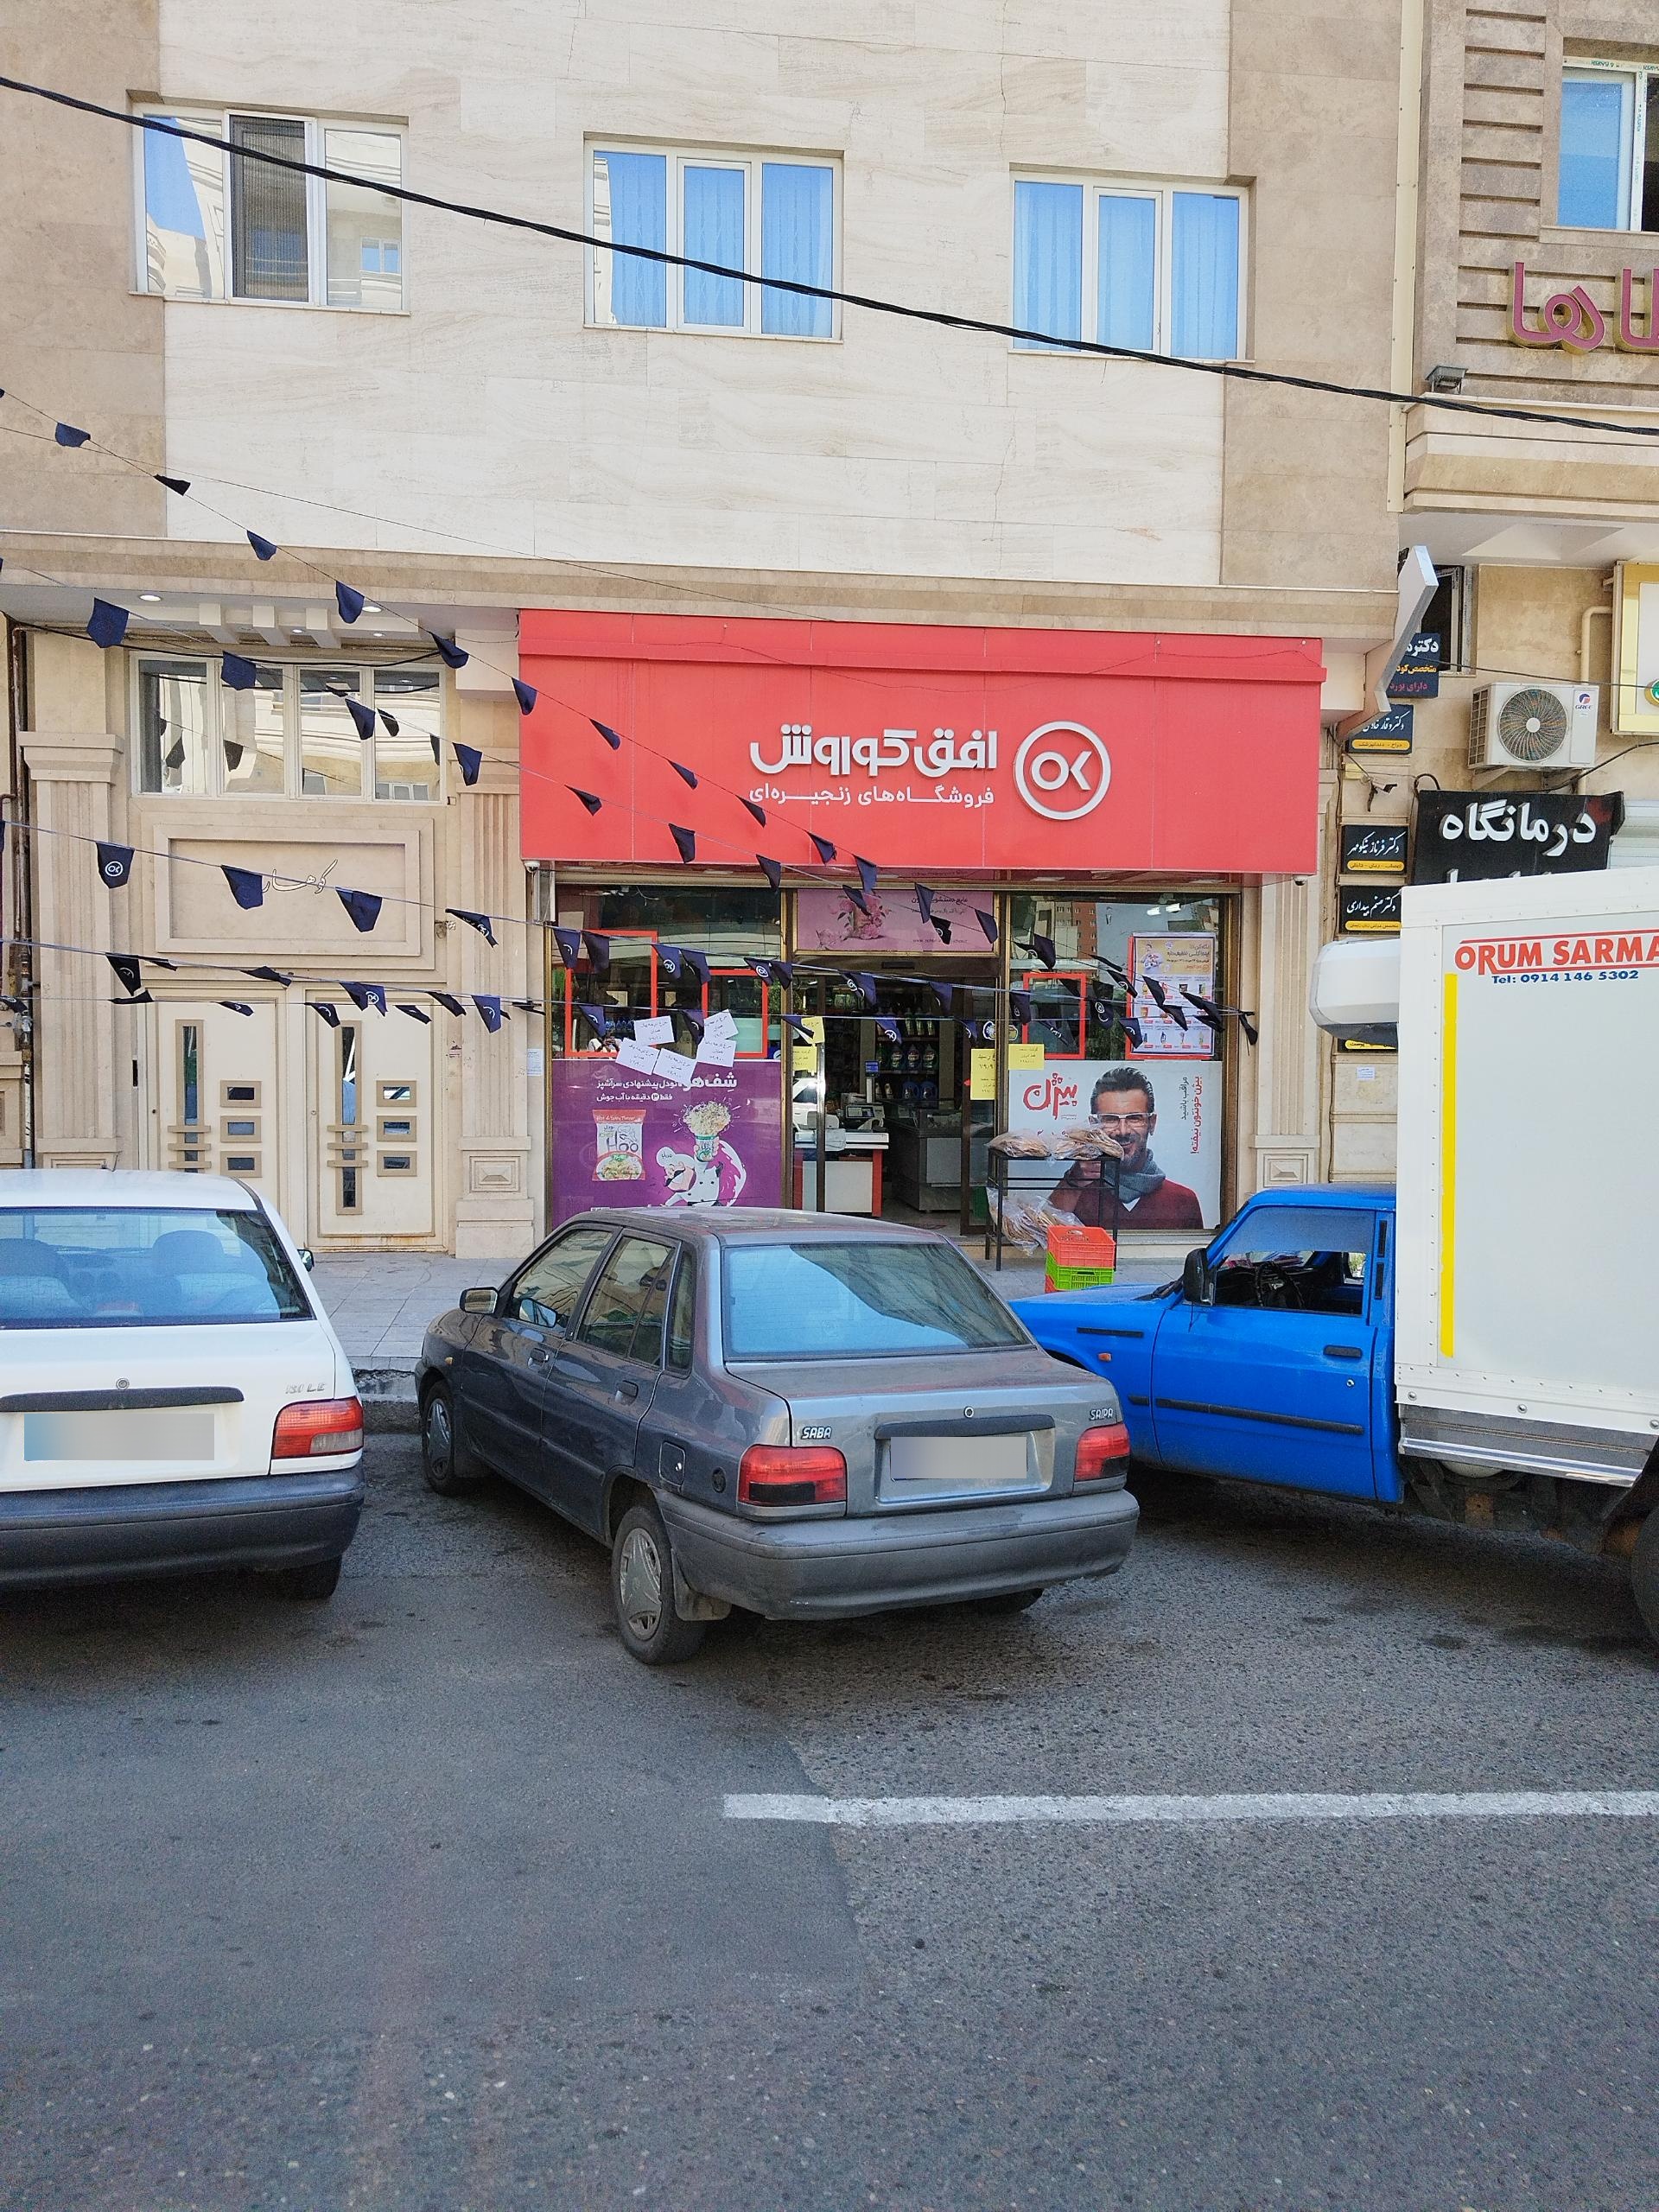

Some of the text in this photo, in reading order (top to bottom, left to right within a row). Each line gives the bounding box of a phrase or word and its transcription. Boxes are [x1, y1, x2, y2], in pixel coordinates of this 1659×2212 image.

[1390, 710, 1411, 733] دکتر
[749, 723, 998, 778] افق کوروش
[1031, 750, 1092, 791] OK
[1440, 798, 1597, 857] درمانگاه
[1383, 831, 1406, 855] دکتر
[1380, 889, 1402, 914] دکتر
[1454, 936, 1659, 976] ORUM SARMA
[1491, 969, 1640, 984] Tel: 0914 146 5302
[596, 1077, 622, 1090] سرآشپز
[622, 1079, 659, 1090] پیشنهادی
[1192, 1076, 1203, 1096] بیژن
[596, 1093, 615, 1102] جوش
[615, 1092, 625, 1102] آب
[625, 1092, 631, 1101] با
[630, 1092, 651, 1102] دقیقه
[1022, 1072, 1078, 1121] بیژن
[1179, 1077, 1190, 1121] مراقب باشید
[1192, 1096, 1202, 1128] خونتون
[1089, 1407, 1114, 1421] SAIPA
[800, 1426, 832, 1440] SABA
